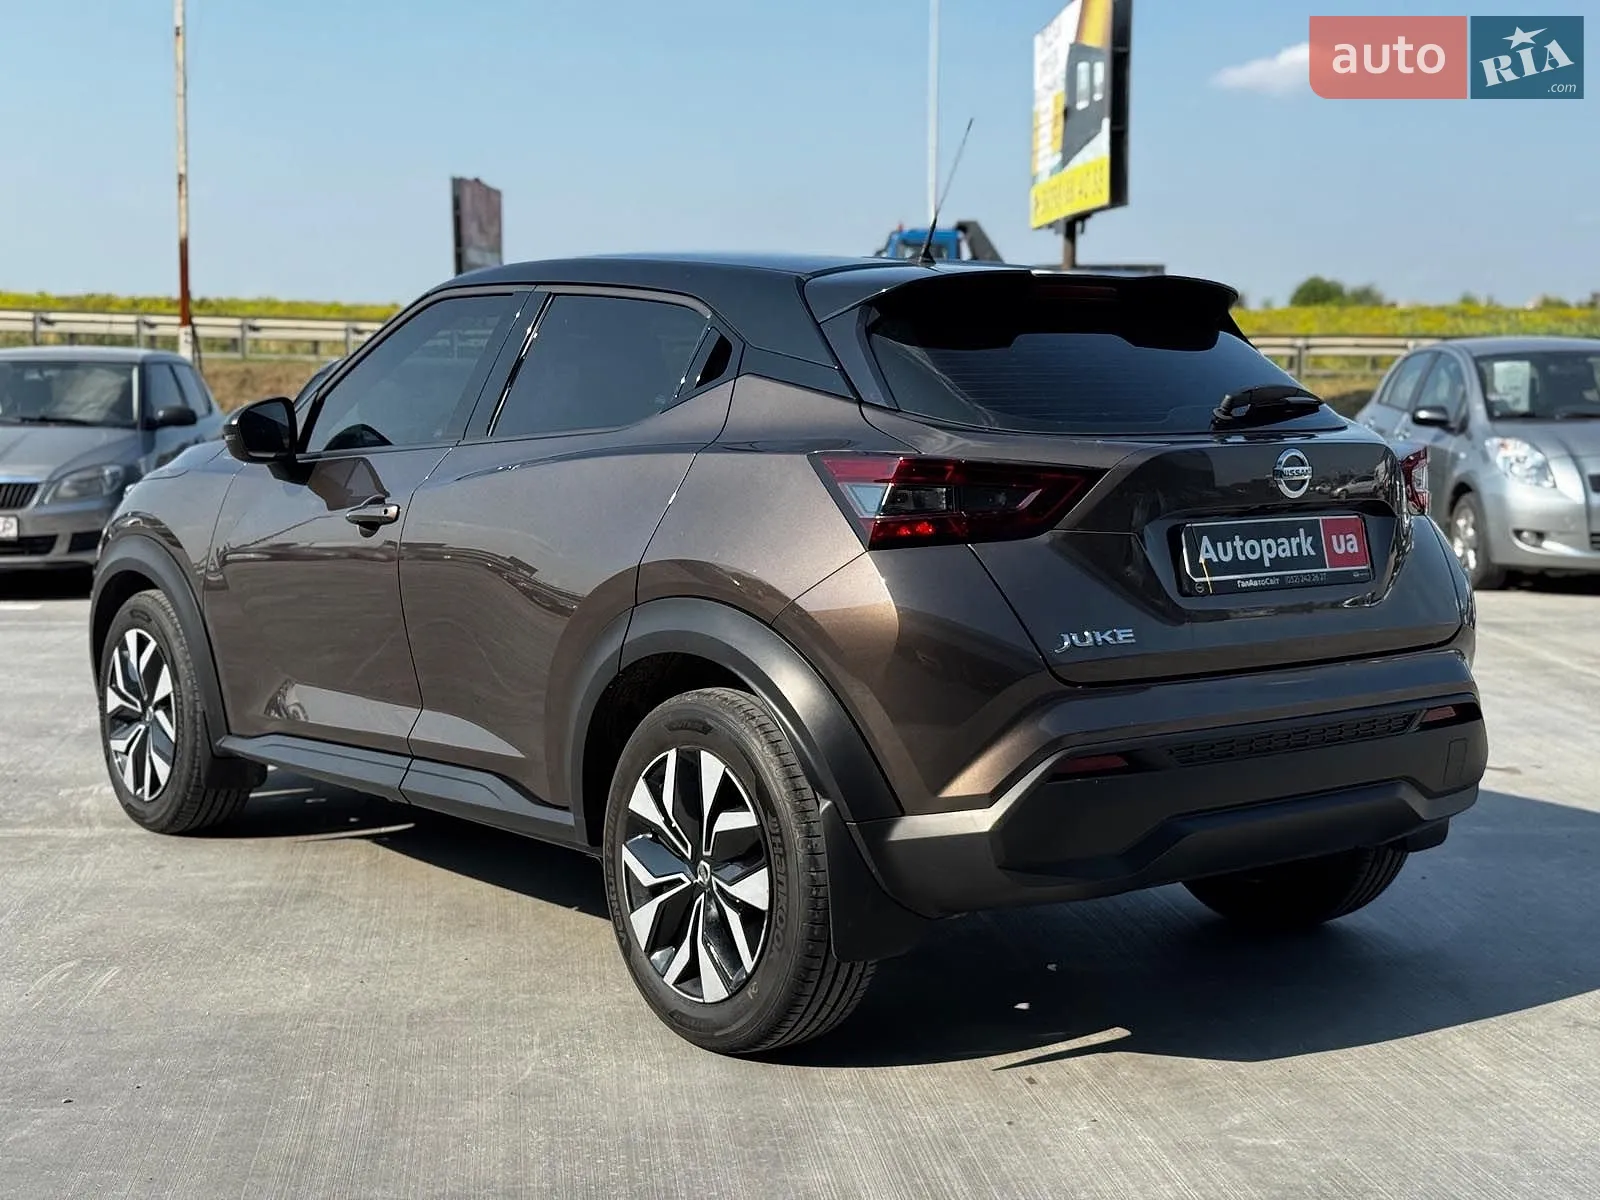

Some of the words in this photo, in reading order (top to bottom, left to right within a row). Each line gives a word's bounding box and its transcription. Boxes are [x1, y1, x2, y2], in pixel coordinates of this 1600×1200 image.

[1198, 528, 1317, 568] Autopark
[1331, 533, 1359, 554] ua
[1054, 628, 1136, 653] JUKE
